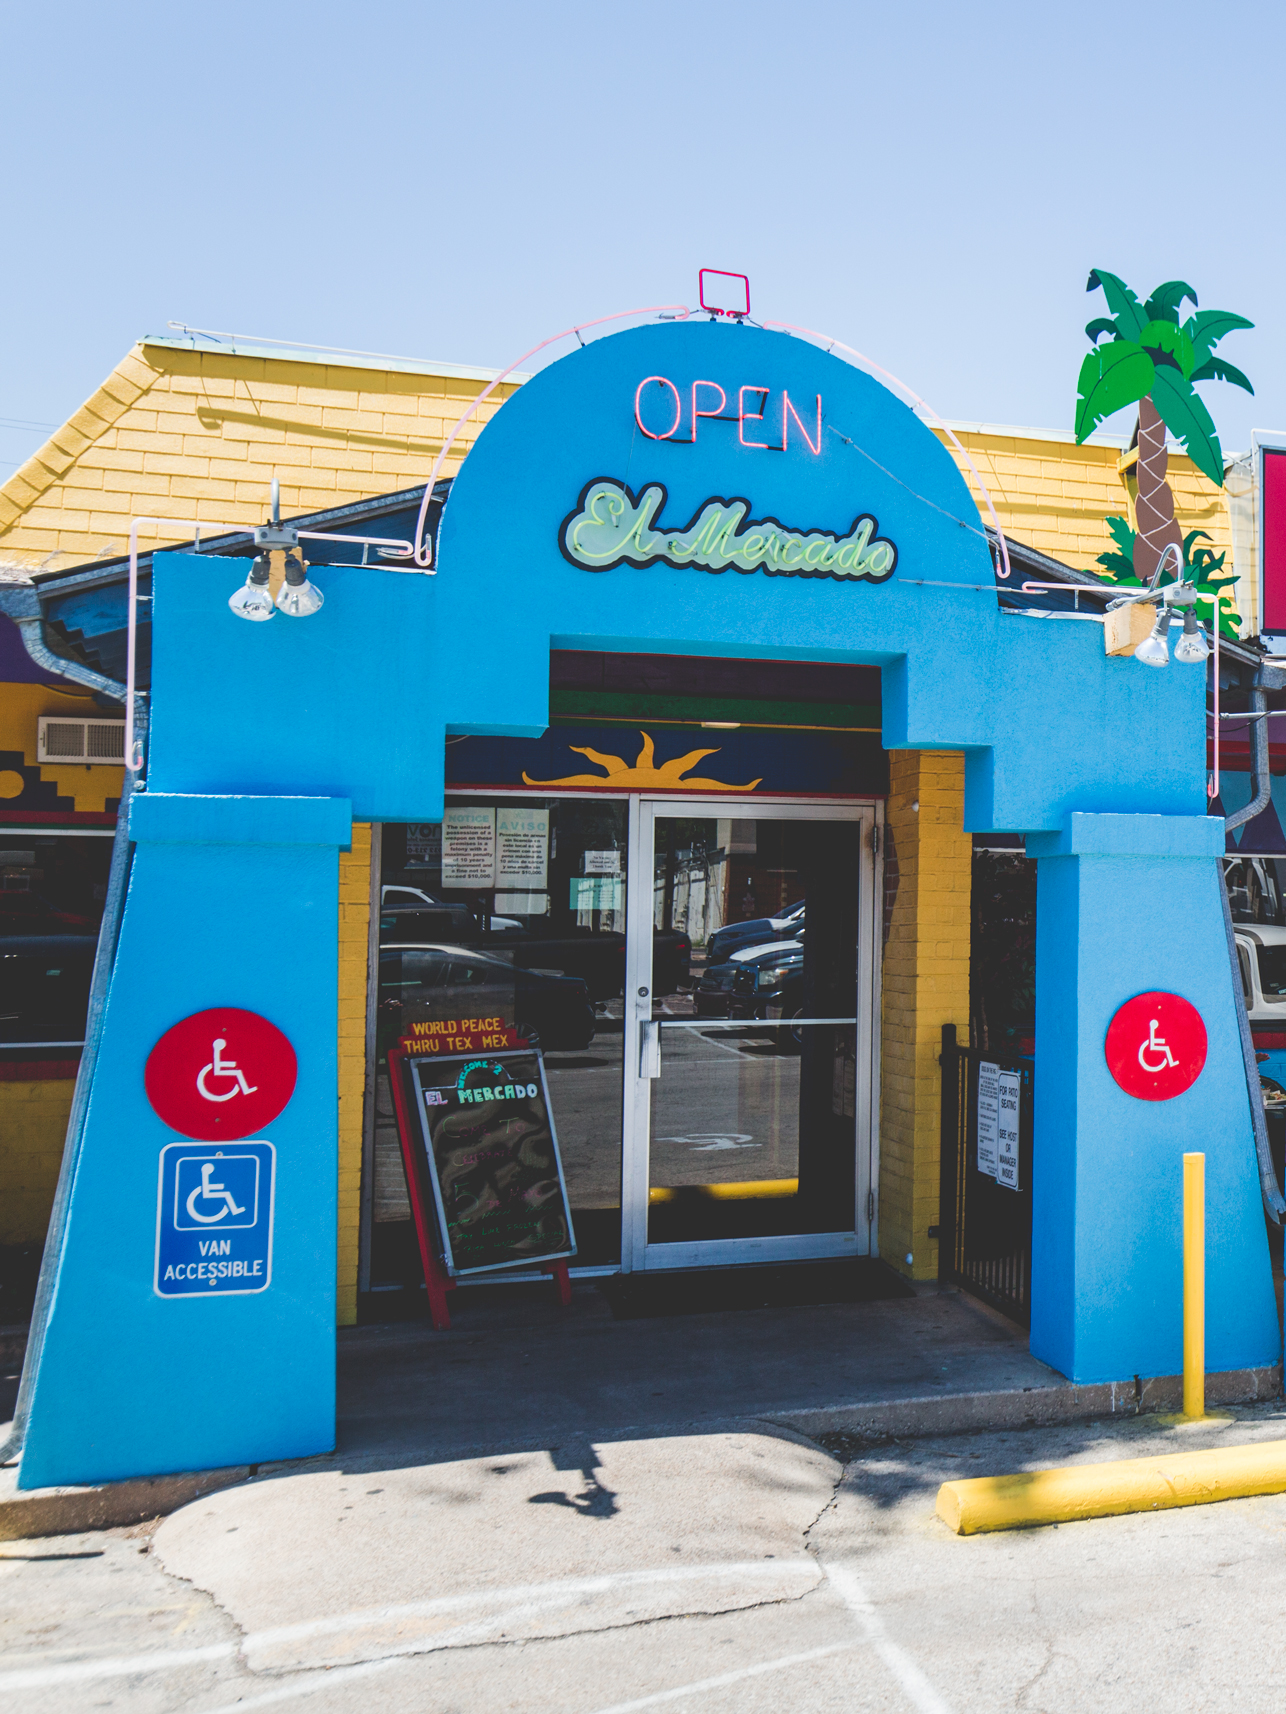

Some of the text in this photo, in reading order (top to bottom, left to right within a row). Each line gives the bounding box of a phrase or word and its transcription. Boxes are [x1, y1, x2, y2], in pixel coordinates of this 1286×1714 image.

[635, 375, 822, 455] OPEN
[565, 482, 896, 577] El Mercado
[448, 814, 490, 823] NOTICE
[500, 822, 547, 831] AVISO
[412, 1017, 502, 1036] WORLD PEACE
[404, 1034, 509, 1054] THRU TEX MEX
[458, 1061, 489, 1089] WELCOME
[425, 1083, 538, 1106] EL MERCADO
[1006, 1143, 1011, 1153] OR
[455, 1182, 479, 1214] 5
[199, 1240, 231, 1257] VAN
[164, 1260, 263, 1281] ACCESSIBLE
